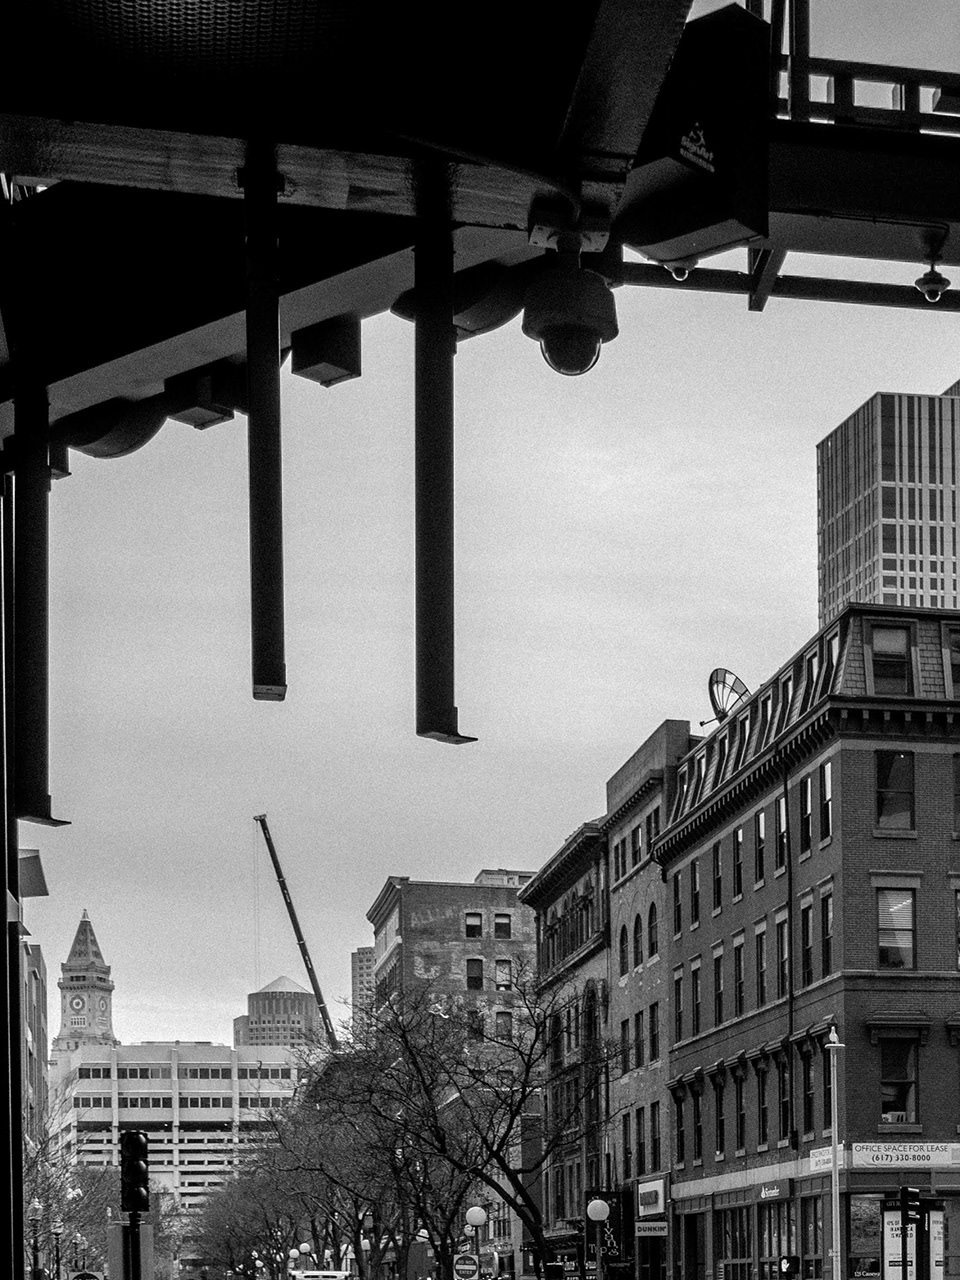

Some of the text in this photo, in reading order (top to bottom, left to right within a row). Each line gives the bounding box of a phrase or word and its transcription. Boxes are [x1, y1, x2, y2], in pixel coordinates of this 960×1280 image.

[854, 1144, 949, 1153] OFFICE SPACE FOR LEASE
[871, 1154, 931, 1163] (617) 330-8000
[637, 1225, 667, 1233] DUNKIN'
